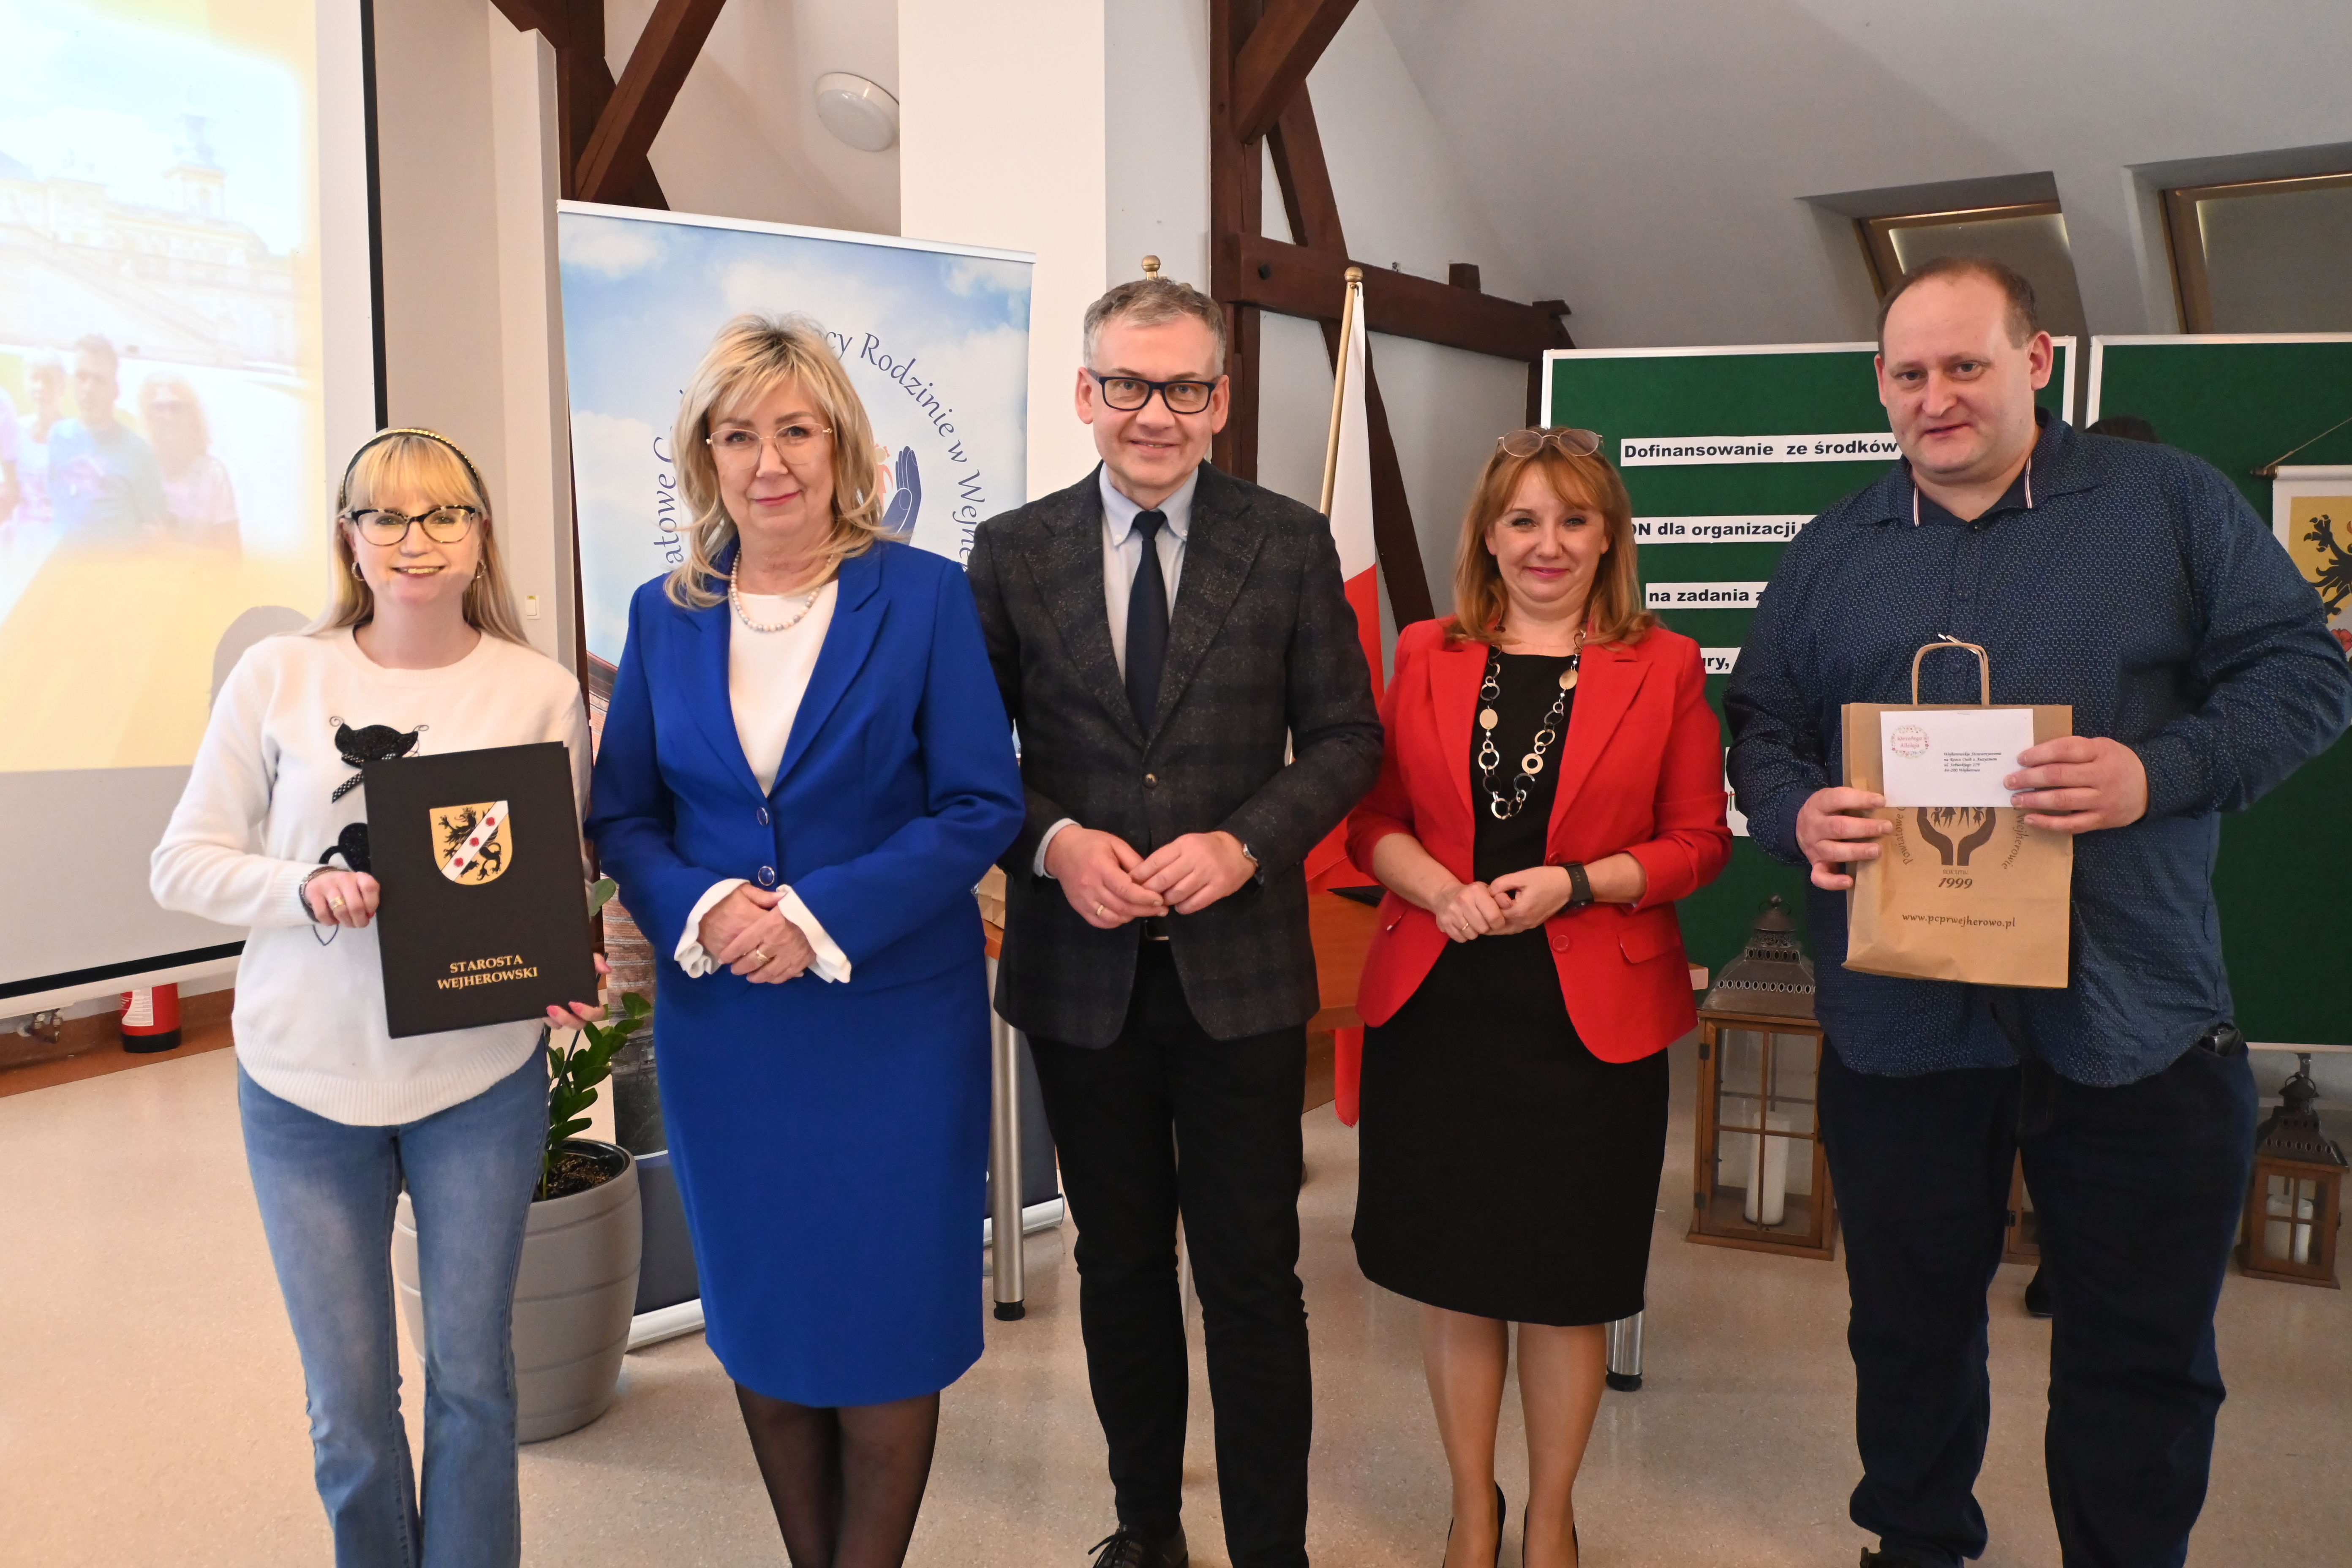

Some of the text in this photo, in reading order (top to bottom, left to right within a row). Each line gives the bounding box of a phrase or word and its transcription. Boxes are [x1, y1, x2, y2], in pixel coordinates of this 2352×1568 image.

[860, 332, 954, 437] Rodzinie
[948, 439, 967, 463] w
[1624, 439, 1898, 458] Dofinansowanie ze środków
[653, 473, 684, 564] atowe
[1658, 523, 1685, 535] dla
[1691, 522, 1796, 538] organizacji
[1649, 592, 1671, 602] na
[1677, 589, 1749, 602] zadania
[1893, 814, 1914, 866] Powiatowe
[2001, 814, 2029, 869] Wejherowie
[1938, 877, 1973, 889] 1999
[1902, 914, 2015, 929] www.pcprwejherowo.pl
[449, 954, 524, 973] STAROSTA
[437, 966, 539, 990] WEJHEROWSKI
